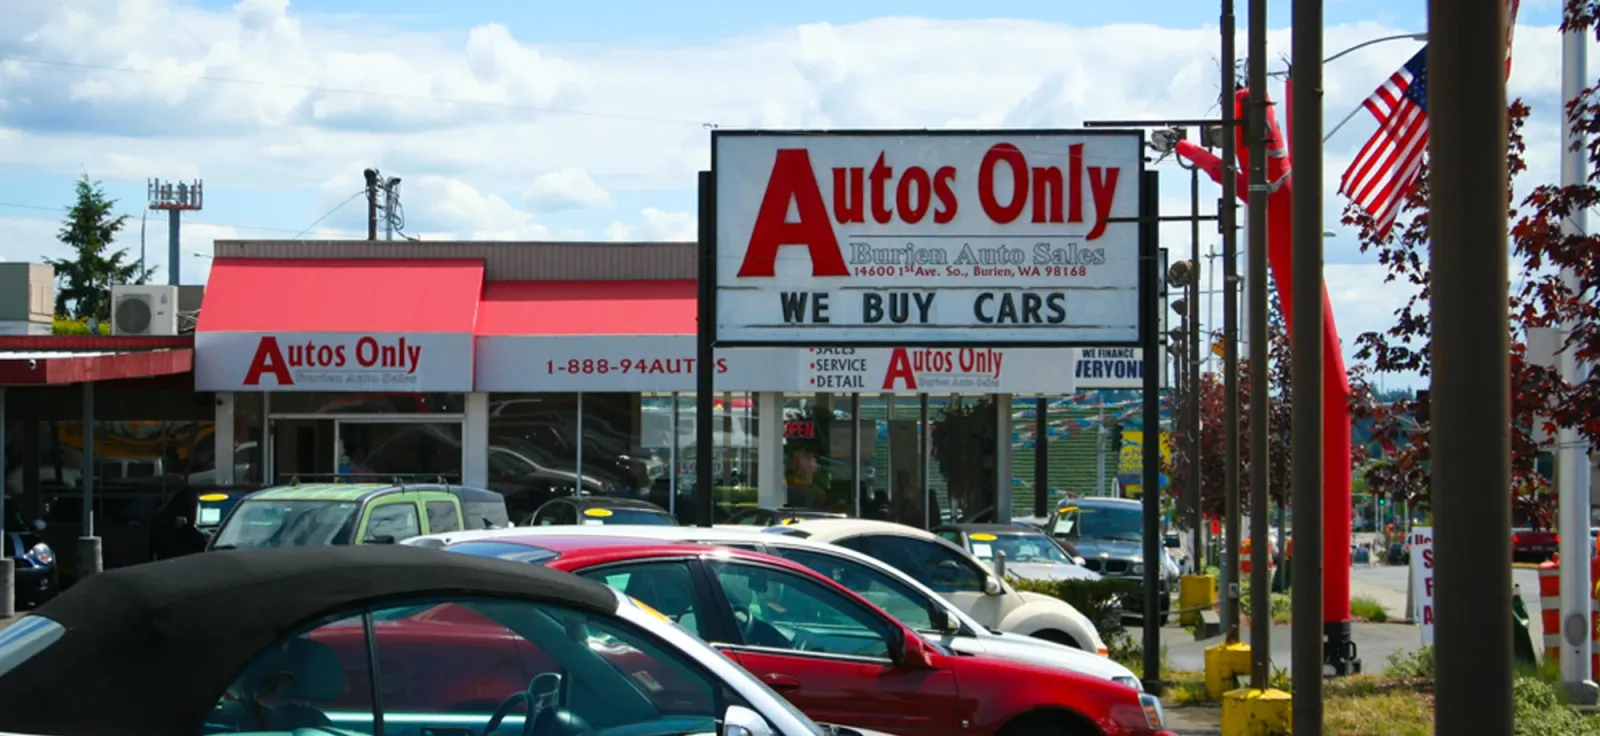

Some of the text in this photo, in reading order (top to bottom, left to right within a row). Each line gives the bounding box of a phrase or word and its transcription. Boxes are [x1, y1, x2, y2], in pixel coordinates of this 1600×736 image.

[737, 142, 1120, 277] Autos Only
[849, 242, 1106, 265] Burien Auto Sales
[854, 266, 895, 277] 14600
[946, 266, 968, 278] So.,
[973, 266, 1015, 278] Burien,
[1018, 266, 1041, 277] WA
[1045, 266, 1087, 277] 98168
[781, 291, 1066, 324] WE BUY CARS
[242, 336, 422, 385] Autos Only
[1082, 349, 1134, 358] WE FINANCE
[547, 358, 728, 375] 1-888-94AUTS
[815, 358, 867, 372] SERVICE
[881, 347, 1003, 390] Autos Only
[816, 375, 864, 388] DETAIL
[783, 421, 814, 437] OPEN
